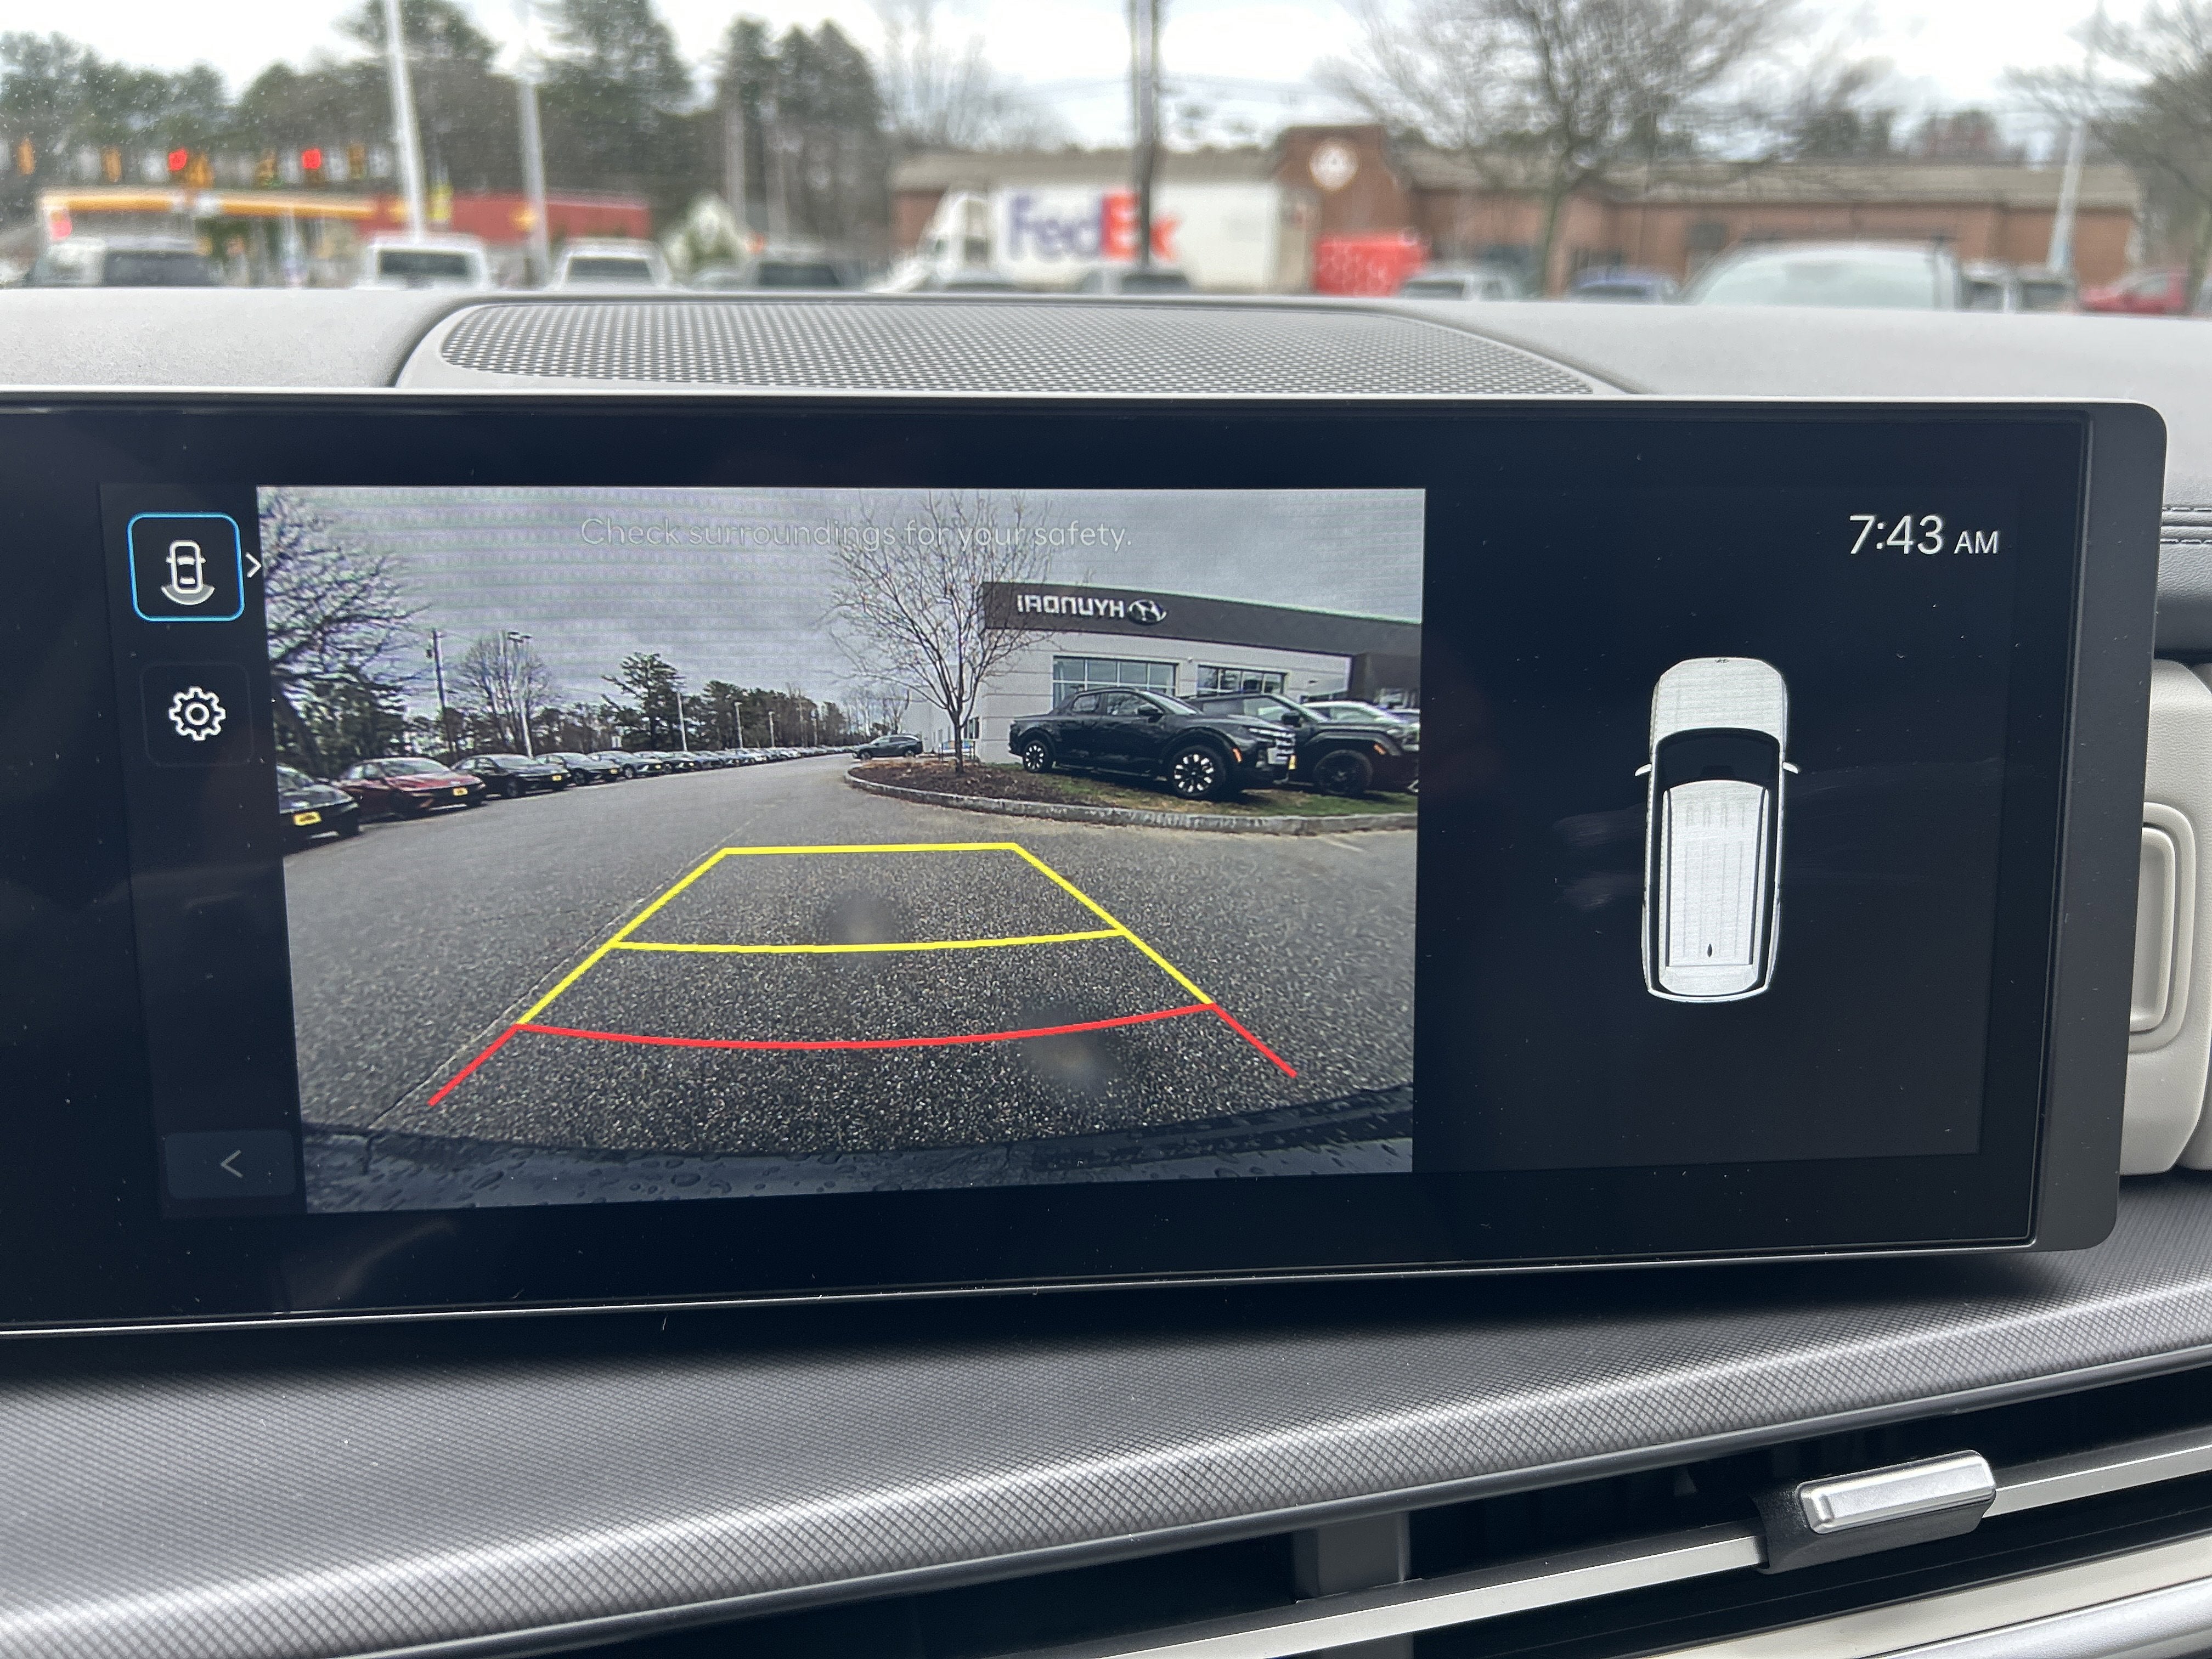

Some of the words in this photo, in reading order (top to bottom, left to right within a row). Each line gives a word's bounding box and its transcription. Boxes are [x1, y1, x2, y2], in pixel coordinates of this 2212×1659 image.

[581, 517, 679, 545] Check
[689, 518, 896, 551] surroundings
[904, 520, 951, 545] for
[958, 527, 1026, 552] your
[1034, 521, 1132, 551] safety.
[1849, 514, 1945, 555] 7:43
[1953, 530, 2000, 555] AM
